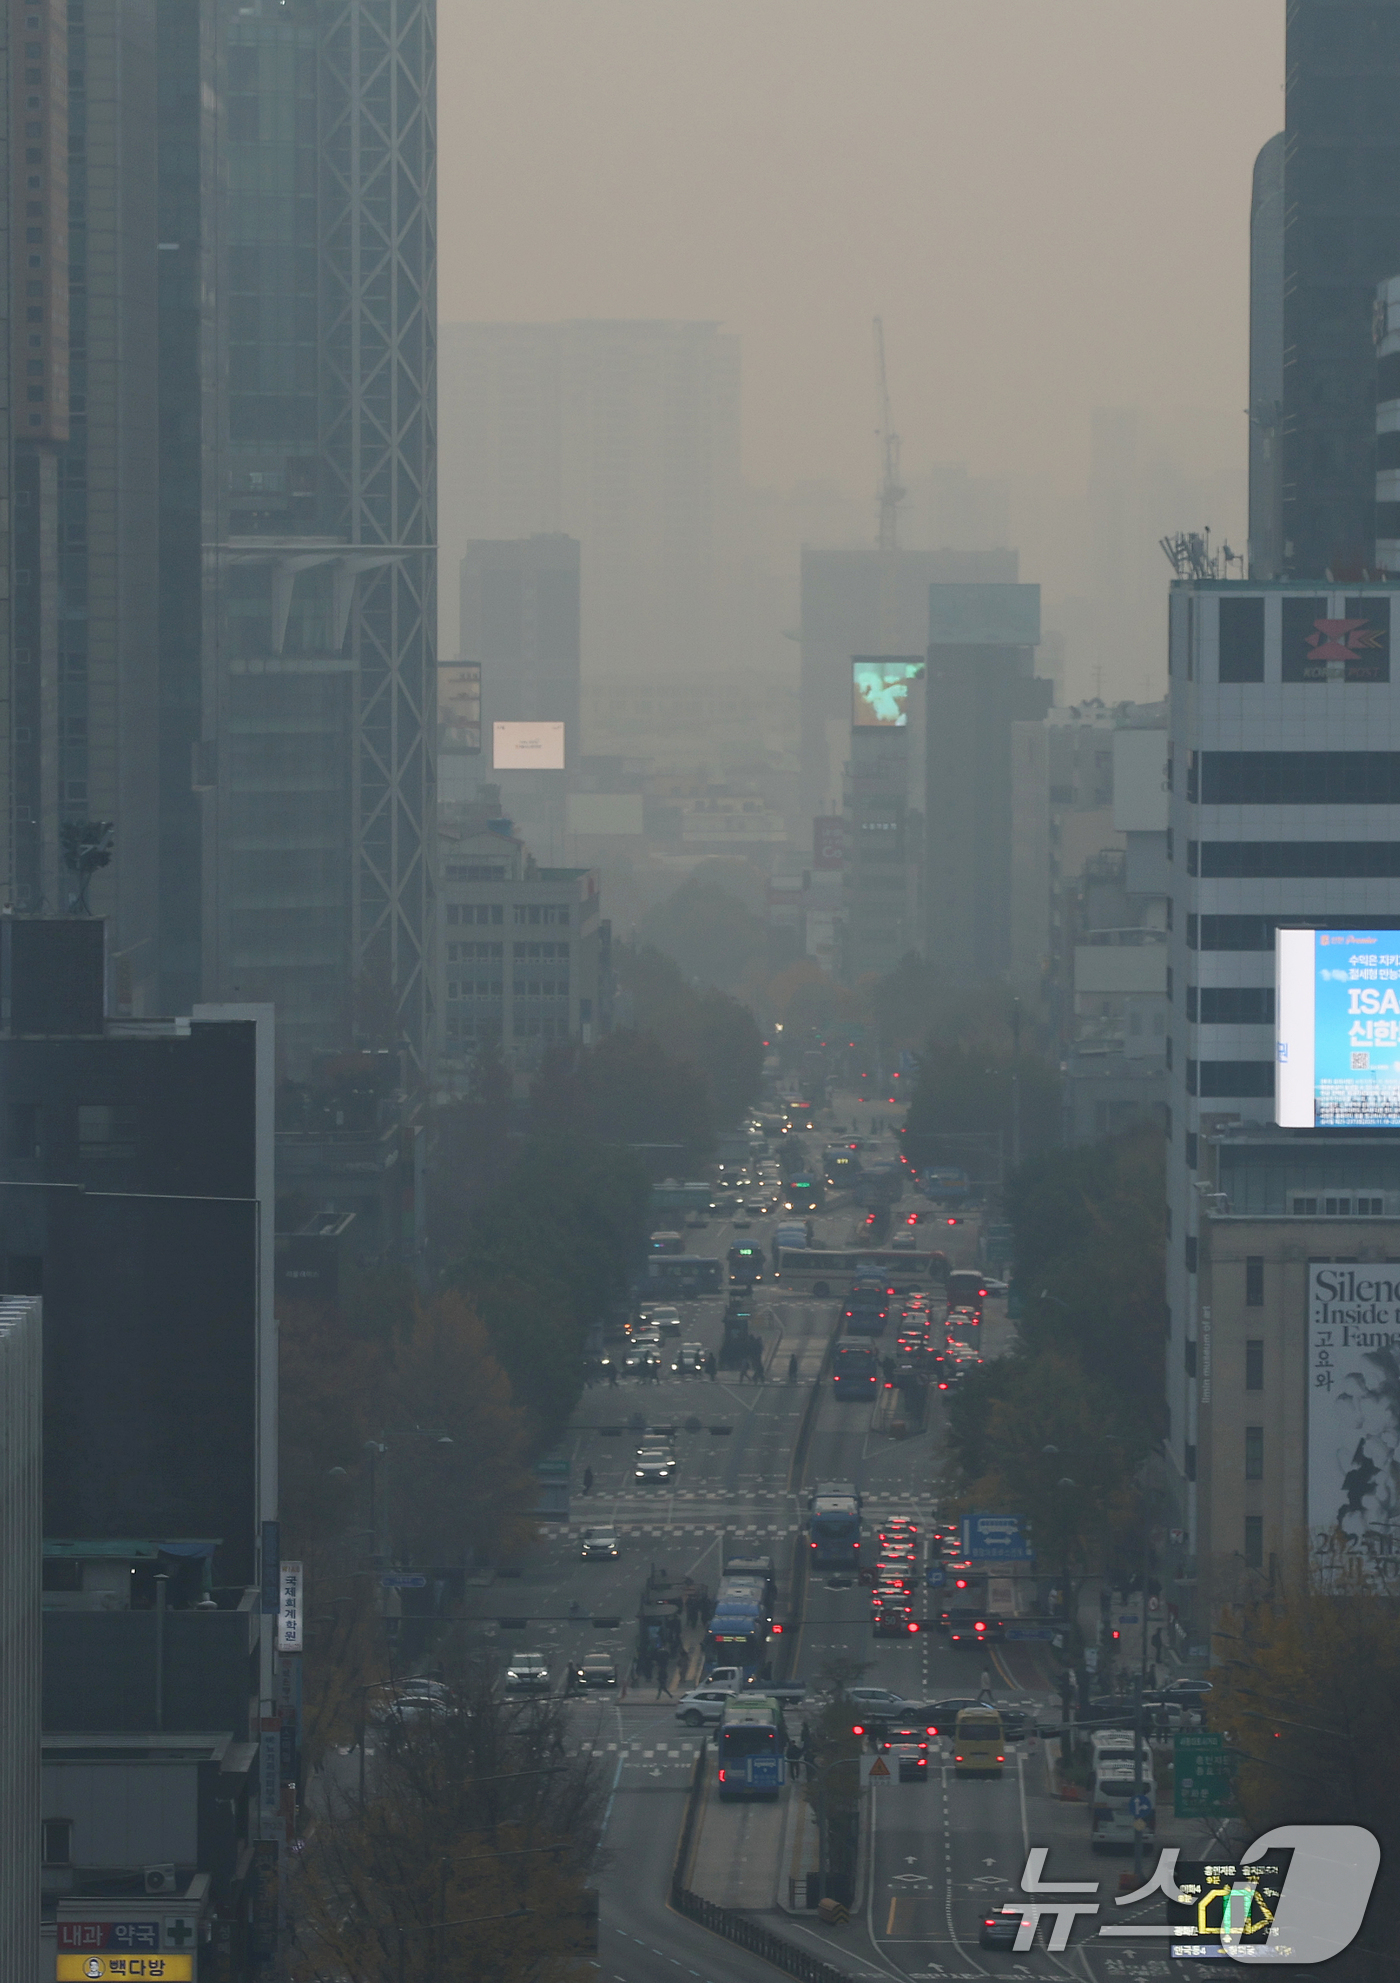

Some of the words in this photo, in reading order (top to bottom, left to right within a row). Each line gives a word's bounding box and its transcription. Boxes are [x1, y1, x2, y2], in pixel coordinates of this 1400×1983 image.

[1348, 954, 1378, 967] 수익은
[1200, 1333, 1211, 1377] museum
[1314, 1330, 1335, 1392] 고요와
[284, 1575, 298, 1642] 국제회계학원
[62, 1924, 103, 1947] 내과
[114, 1924, 156, 1947] 약국
[108, 1959, 166, 1977] 빽다방
